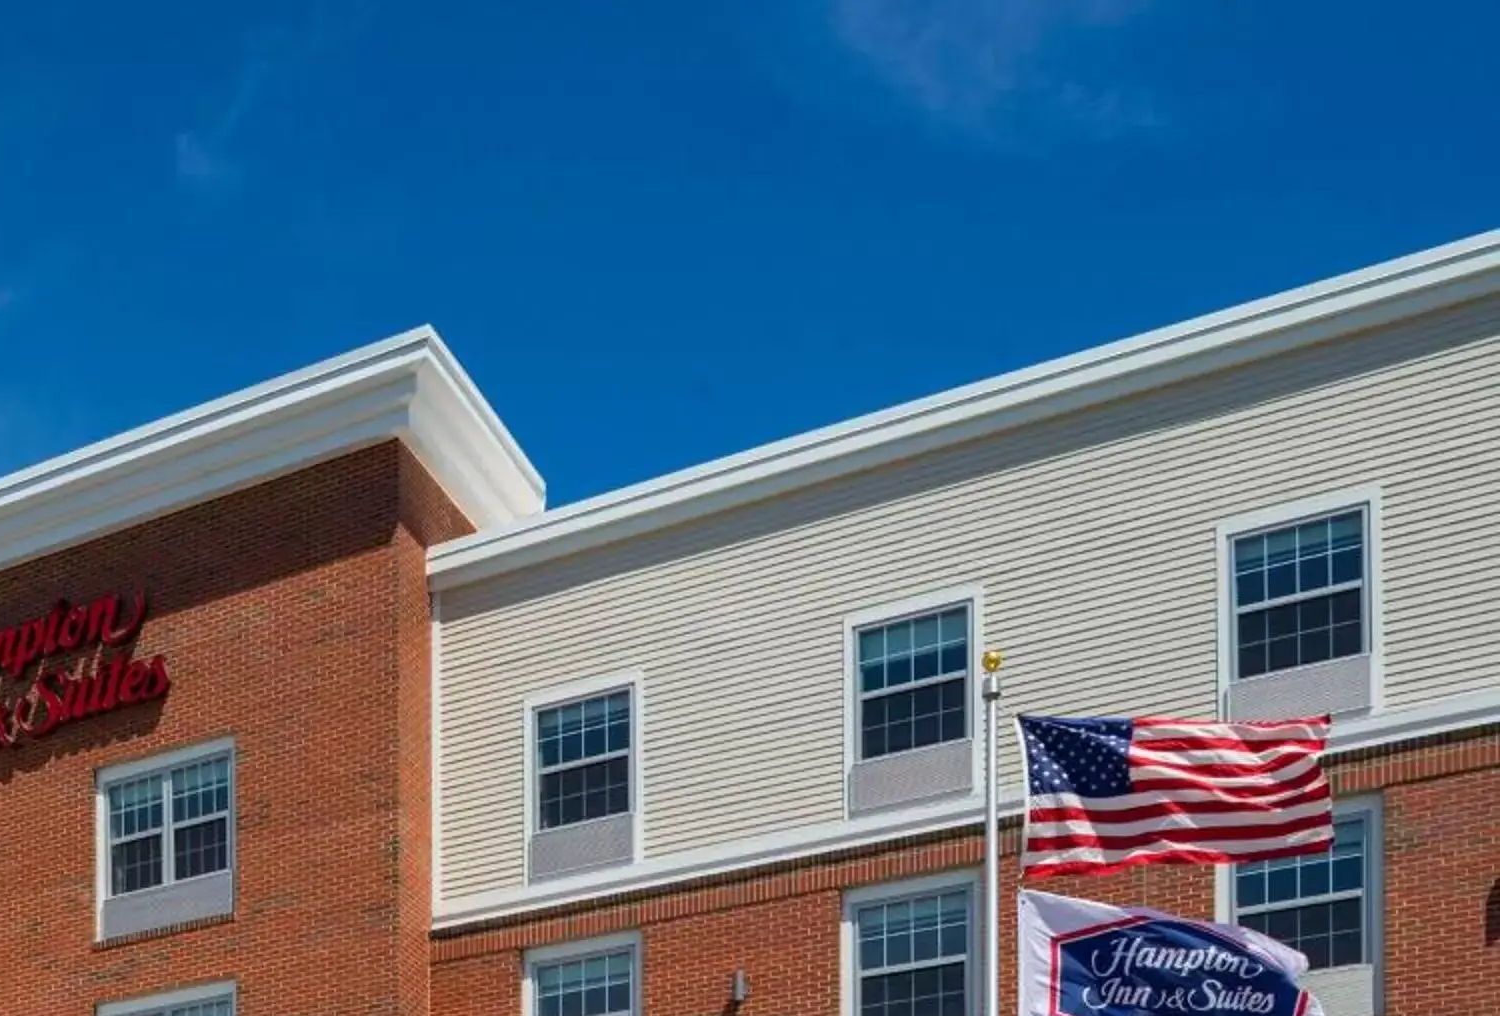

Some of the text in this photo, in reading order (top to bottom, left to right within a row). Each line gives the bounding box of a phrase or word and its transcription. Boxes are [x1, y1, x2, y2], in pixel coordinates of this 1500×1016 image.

[17, 653, 171, 739] Suites
[1091, 937, 1263, 979] Hampton
[1082, 978, 1275, 1014] Inn & Suites
